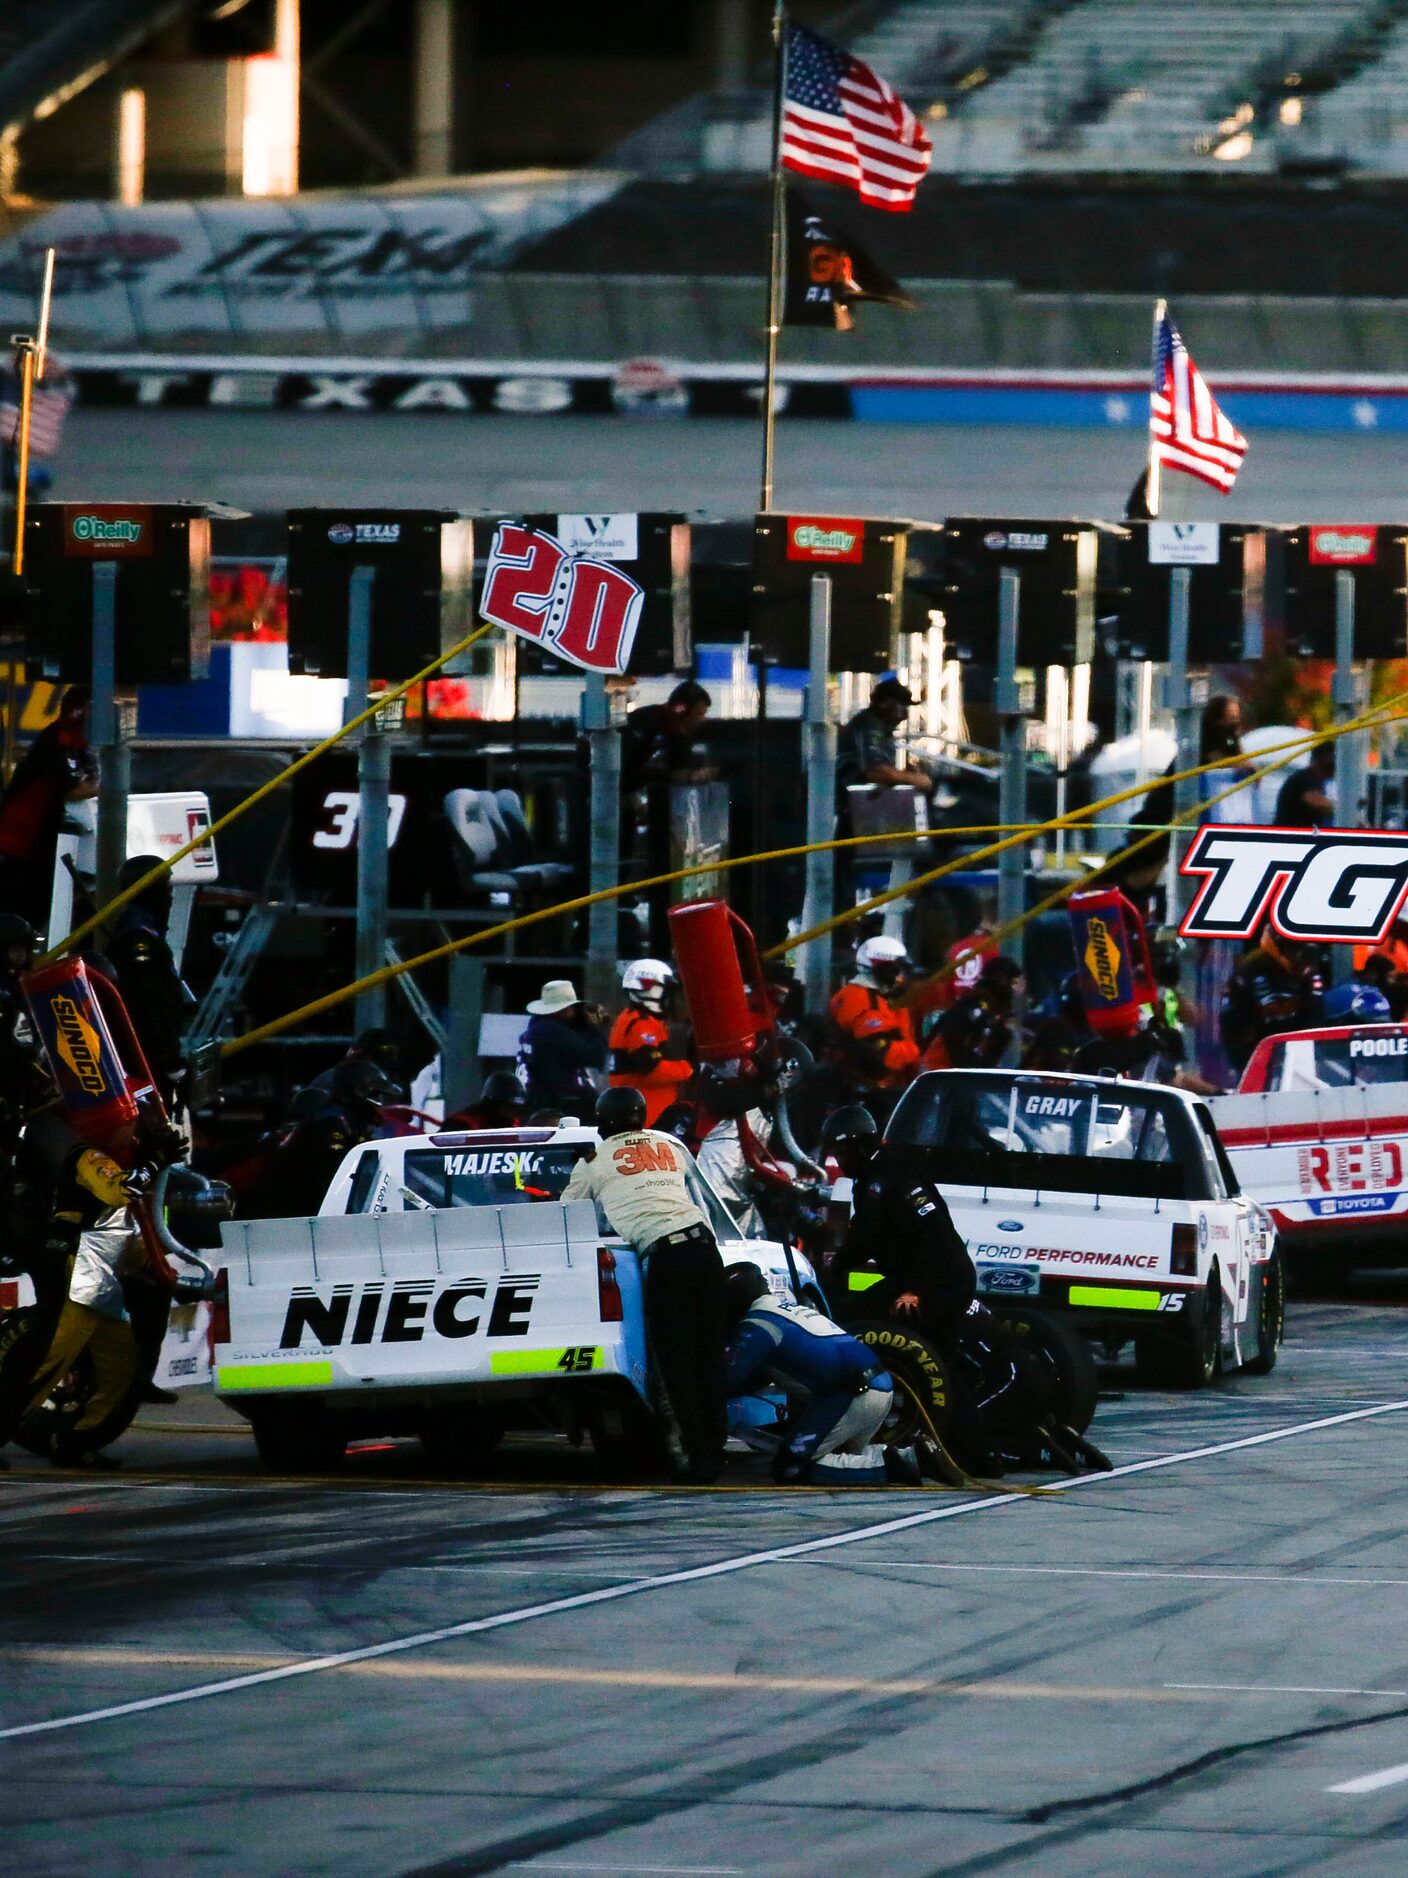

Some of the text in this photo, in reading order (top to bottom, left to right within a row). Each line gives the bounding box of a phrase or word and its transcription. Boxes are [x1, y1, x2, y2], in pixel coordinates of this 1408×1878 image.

[118, 372, 572, 412] TEXAS
[74, 516, 141, 542] O'Reilly
[355, 524, 400, 537] TEXAS
[484, 523, 643, 673] 20
[52, 1000, 104, 1090] SUNOCO
[1350, 1038, 1408, 1057] POOLE
[1025, 1095, 1081, 1118] GRAY
[624, 1138, 651, 1146] ELLIOTT
[613, 1142, 677, 1176] 3M
[1337, 1197, 1386, 1212] TOYOTA
[976, 1244, 1022, 1259] FORD
[1024, 1247, 1159, 1269] PERFORMANCE
[991, 1272, 1023, 1287] Ford
[280, 1273, 542, 1349] NIECE
[1157, 1293, 1186, 1312] 15
[558, 1346, 596, 1373] 45
